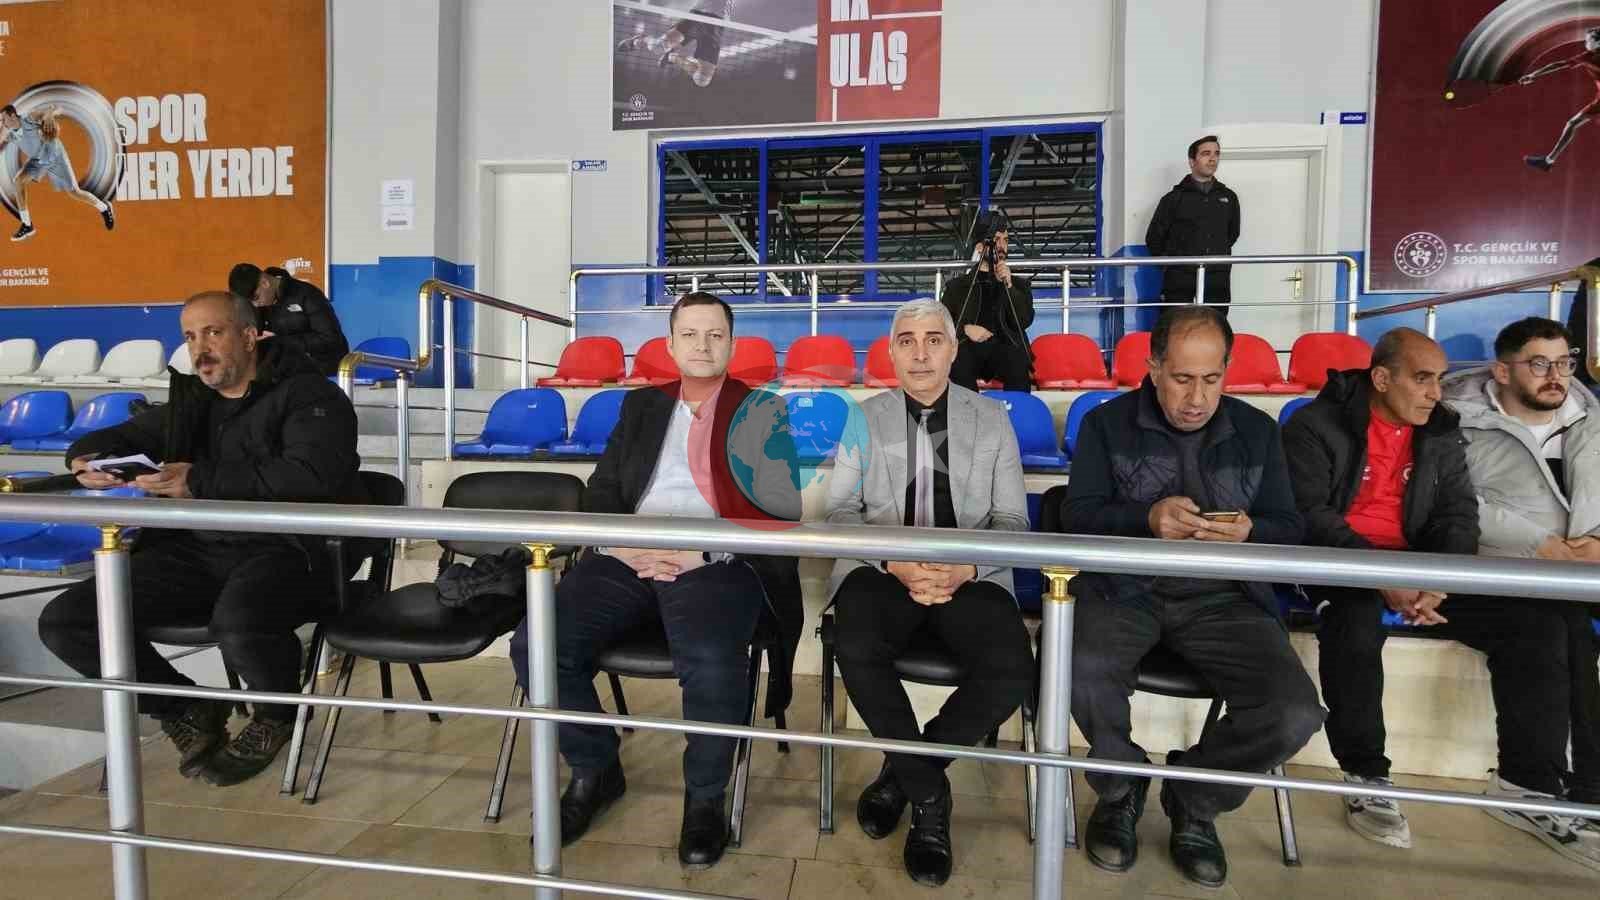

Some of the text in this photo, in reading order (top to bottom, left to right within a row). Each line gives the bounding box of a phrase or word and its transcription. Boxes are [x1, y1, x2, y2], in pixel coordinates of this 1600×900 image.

[830, 31, 908, 91] ULAŞ
[114, 93, 208, 146] SPOR
[115, 146, 294, 201] HER YERDE
[1453, 239, 1560, 254] T.C. GENÇLİK VE
[1453, 252, 1558, 265] SPOR BAKANLIĞI
